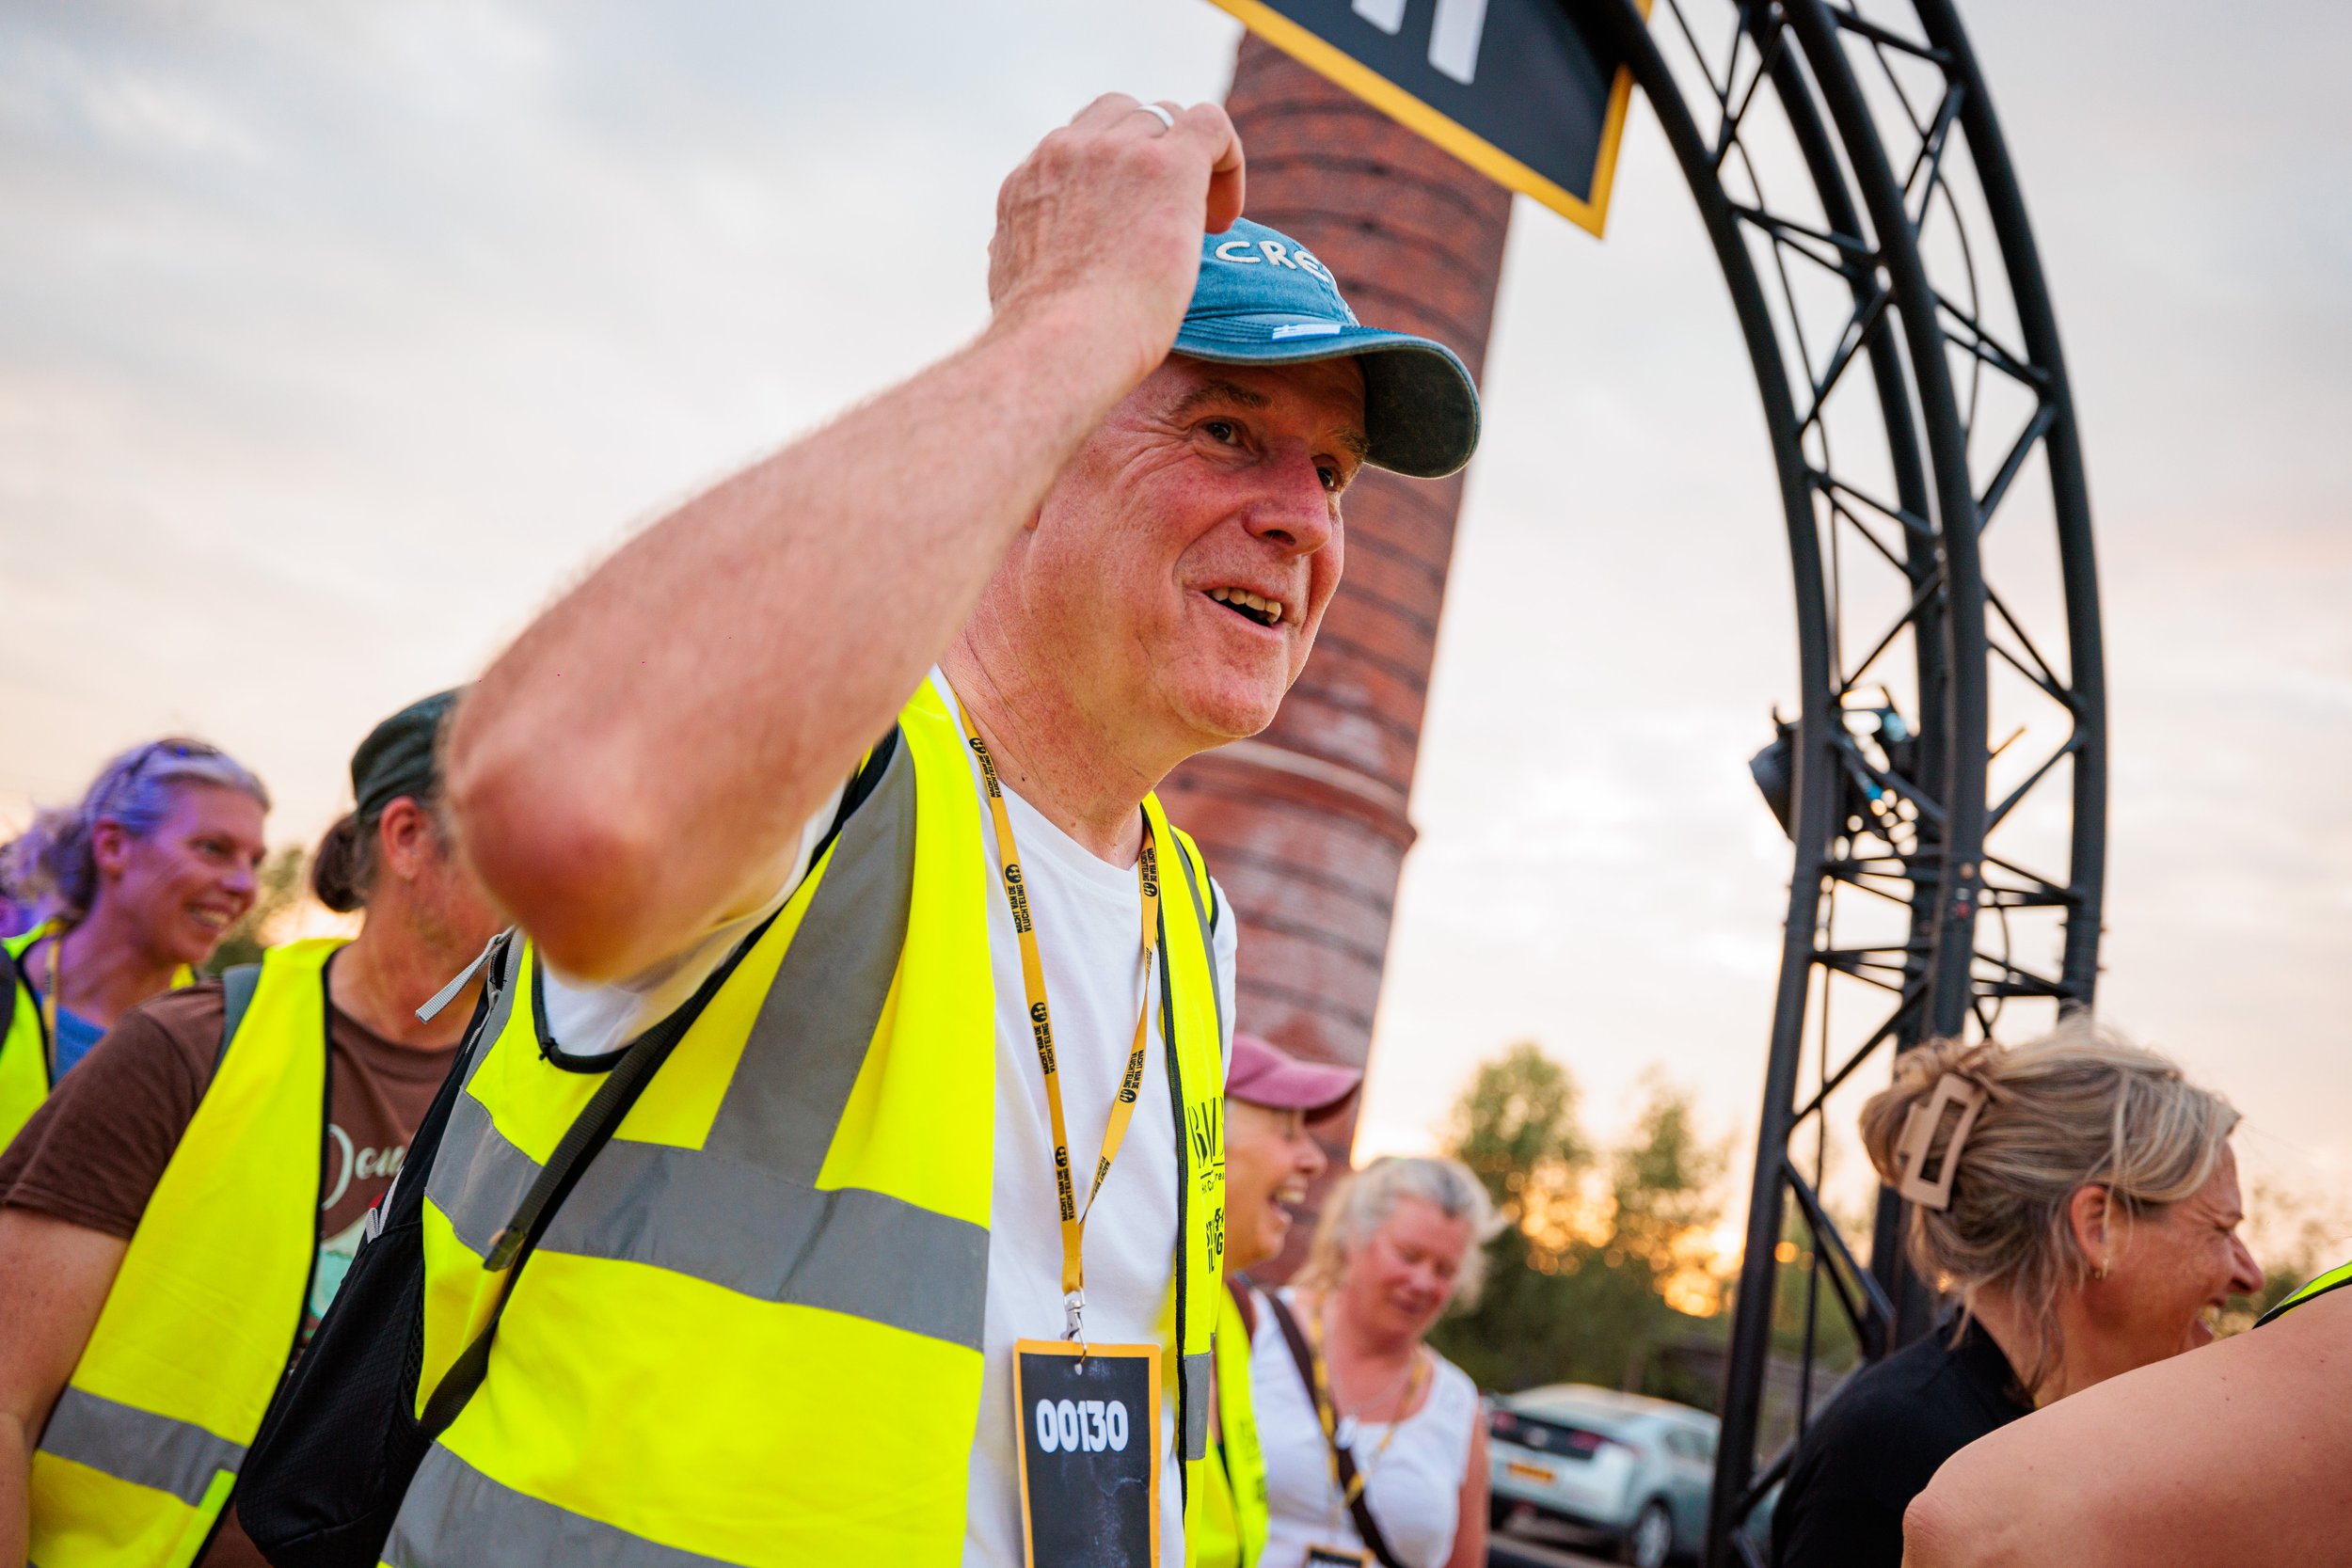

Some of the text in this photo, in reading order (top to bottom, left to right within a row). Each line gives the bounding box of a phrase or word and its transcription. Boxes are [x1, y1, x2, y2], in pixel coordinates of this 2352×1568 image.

[1215, 240, 1337, 290] CRE
[983, 754, 1002, 799] VLUCHTELING
[986, 776, 996, 799] NACHT
[1008, 884, 1024, 934] NACHT VAN DE
[1016, 884, 1032, 933] VLUCHTELING
[1034, 1024, 1051, 1075] NACHT VAN DE
[1041, 1022, 1056, 1073] VLUCHTELING
[1123, 1052, 1138, 1089] VLUCHTELING
[1136, 1050, 1145, 1069] NACHT
[1133, 1069, 1142, 1081] VAN
[1060, 1196, 1069, 1222] NACHT
[1063, 1167, 1075, 1220] VLUCHTELING
[1036, 1398, 1129, 1453] 00130
